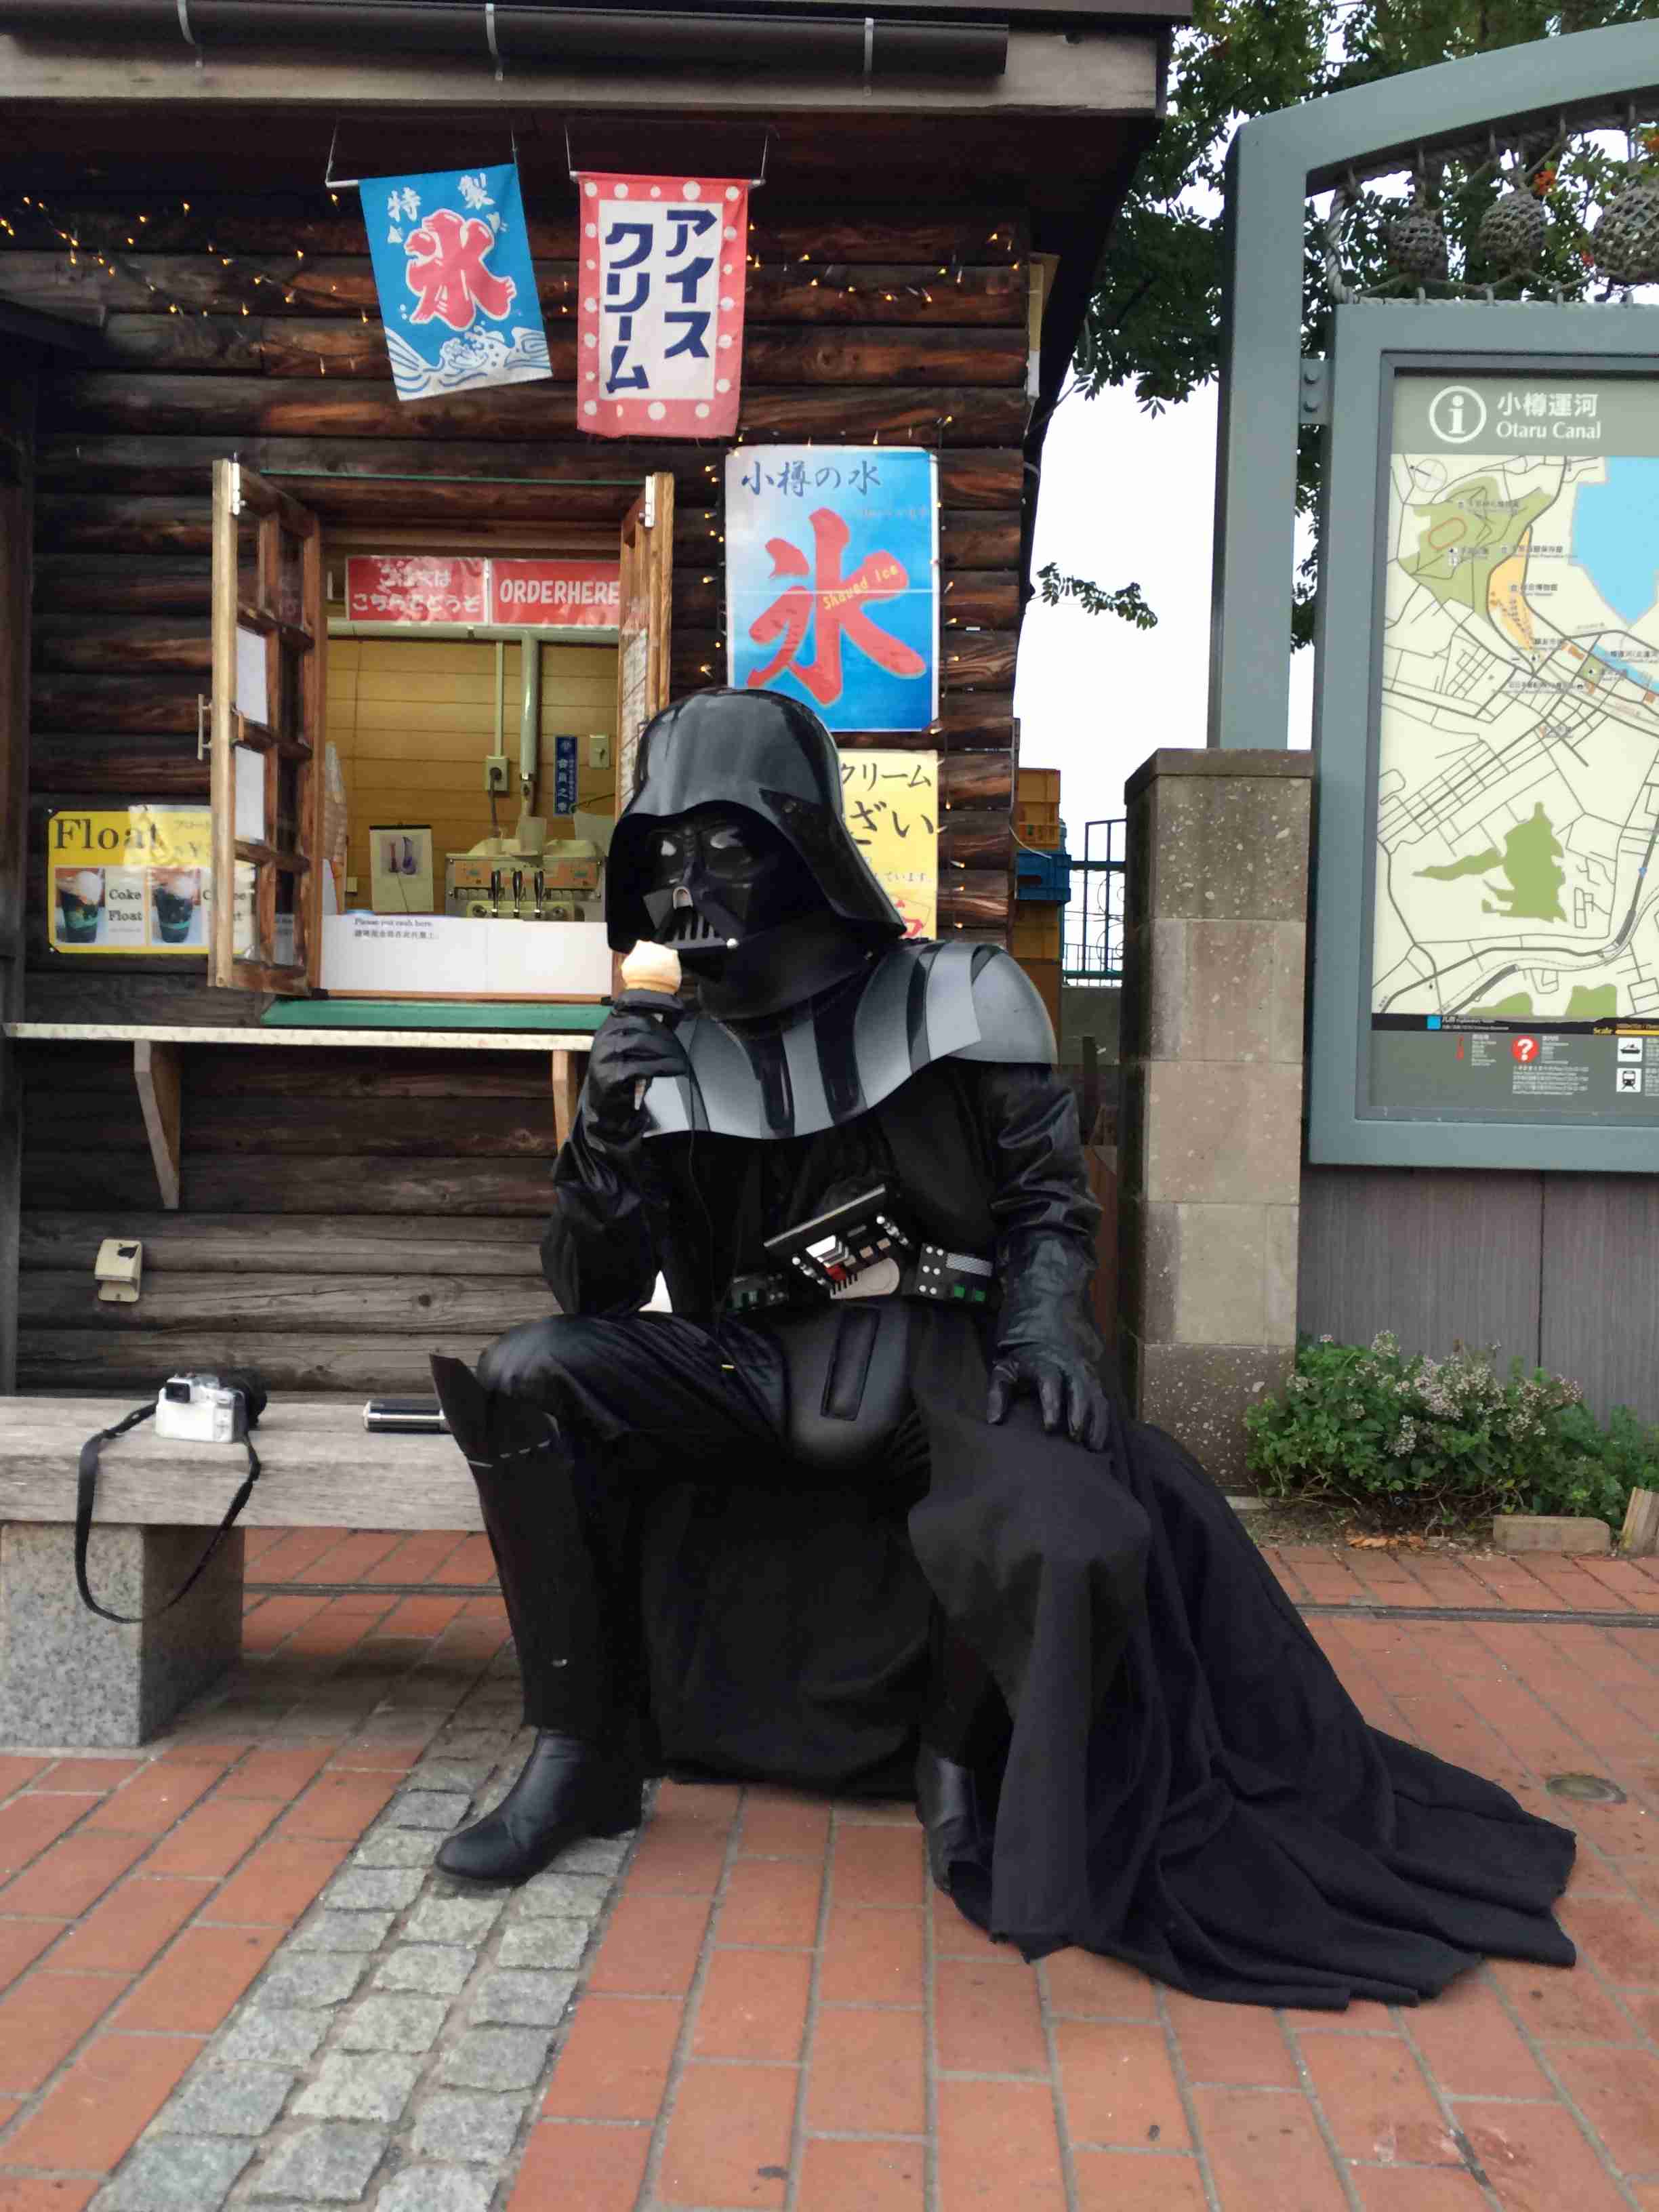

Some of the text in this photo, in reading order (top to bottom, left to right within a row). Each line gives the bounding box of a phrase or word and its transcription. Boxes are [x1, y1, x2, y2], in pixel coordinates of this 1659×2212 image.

[405, 209, 517, 330] 氷
[664, 209, 717, 359] アイス
[605, 222, 651, 394] クリーム
[1497, 392, 1599, 417] 小樽運河
[1496, 420, 1601, 439] Otaru Canal
[875, 564, 898, 583] Ice
[747, 507, 927, 705] 氷
[109, 888, 142, 900] Coke
[108, 910, 142, 921] Float
